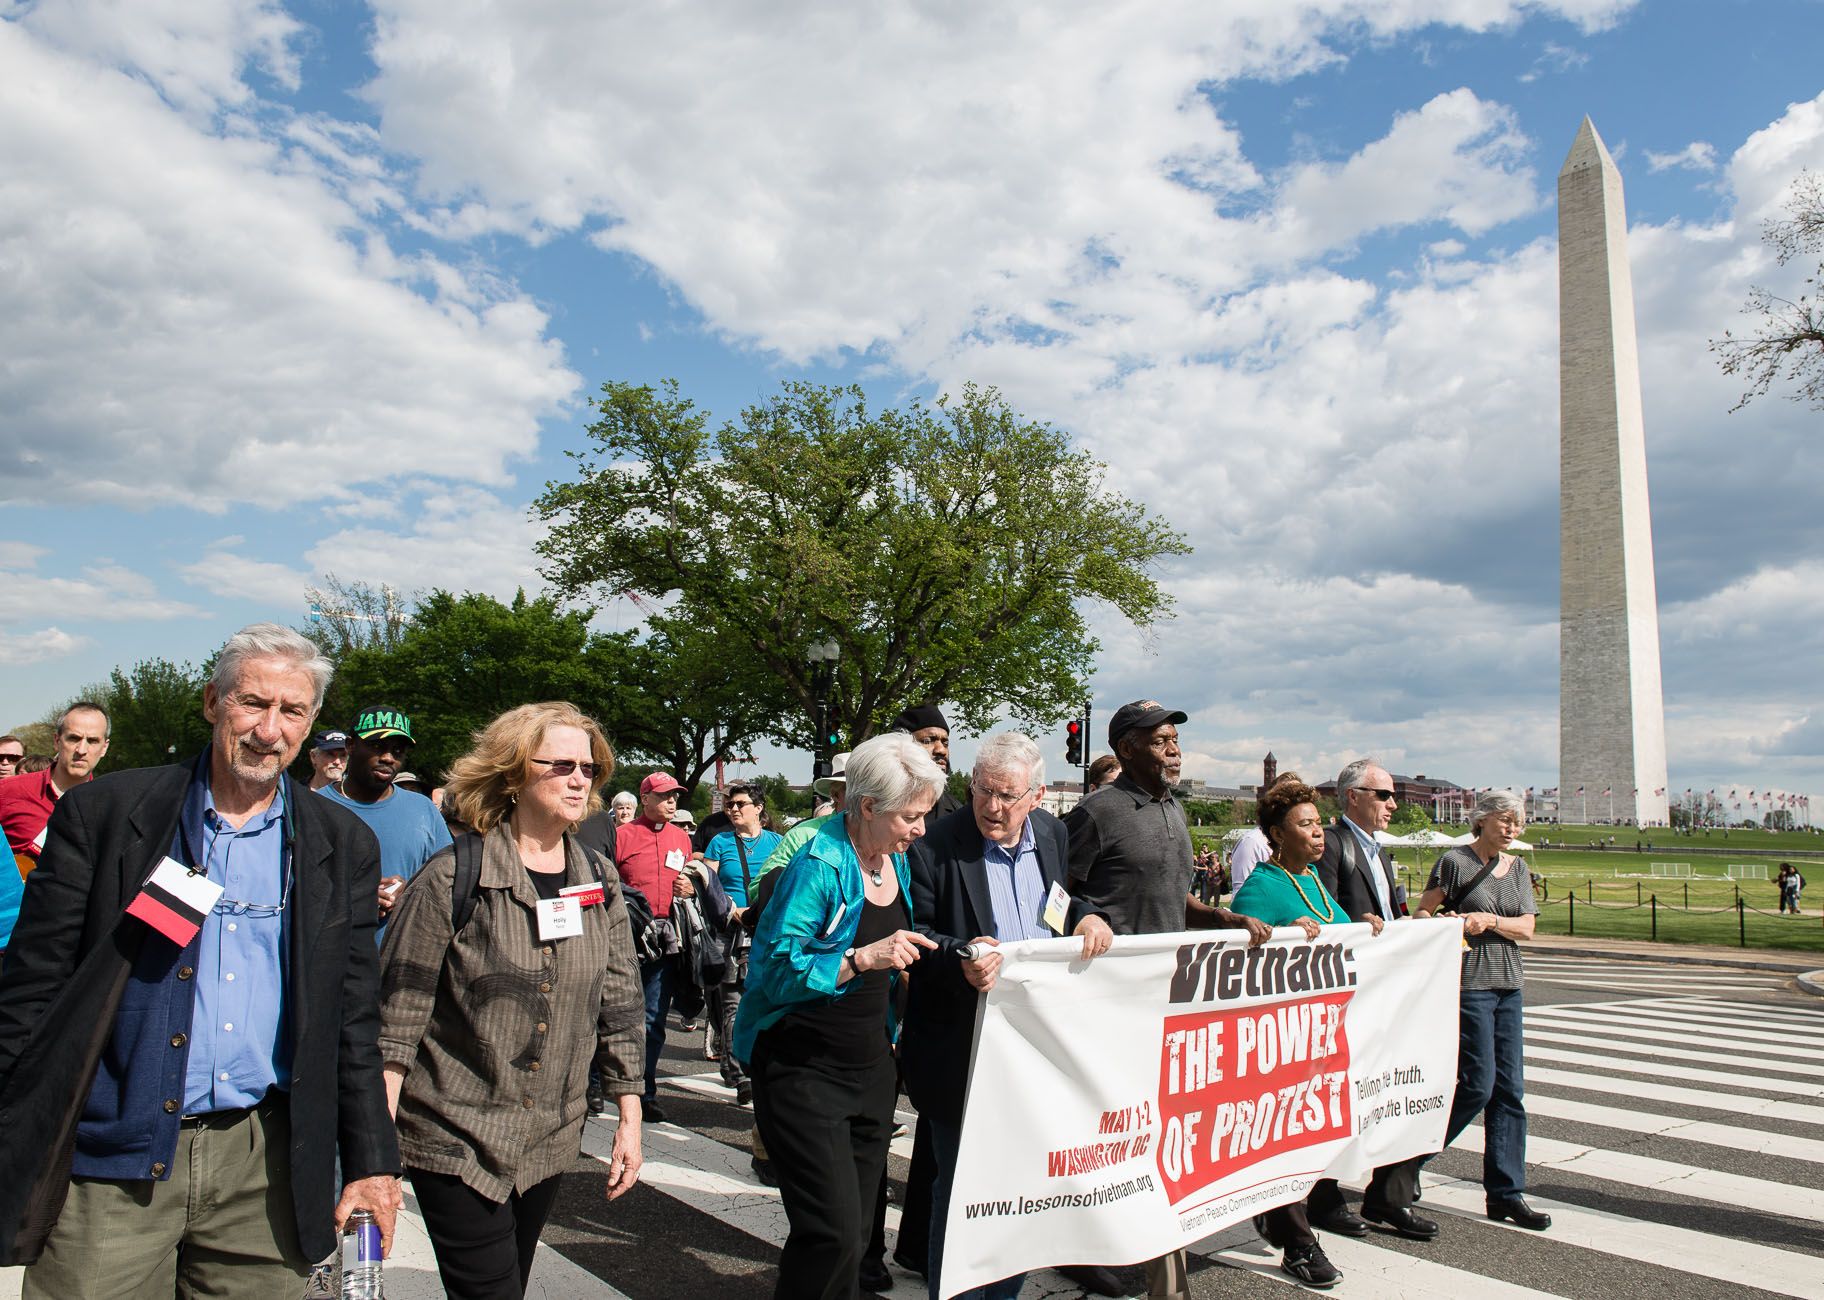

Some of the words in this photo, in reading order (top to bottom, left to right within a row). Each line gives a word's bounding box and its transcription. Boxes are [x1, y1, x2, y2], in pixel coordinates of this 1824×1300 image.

[1168, 941, 1357, 1004] Vietnam:
[1165, 1021, 1224, 1095] THE
[1236, 1002, 1342, 1078] POWER
[1394, 1065, 1425, 1086] truth.
[1099, 1107, 1132, 1135] MAY
[1136, 1100, 1152, 1130] 1-2
[1162, 1111, 1202, 1183] OF
[1210, 1071, 1347, 1164] PROTEST
[1405, 1094, 1445, 1116] lessons.
[1048, 1139, 1130, 1178] WASHINGTON
[1131, 1133, 1151, 1158] DC
[965, 1173, 1155, 1220] www.lessonsofvietnam.org
[1179, 1213, 1207, 1232] Vietnam
[1206, 1204, 1229, 1222] Peace
[1228, 1184, 1289, 1212] Commemoration
